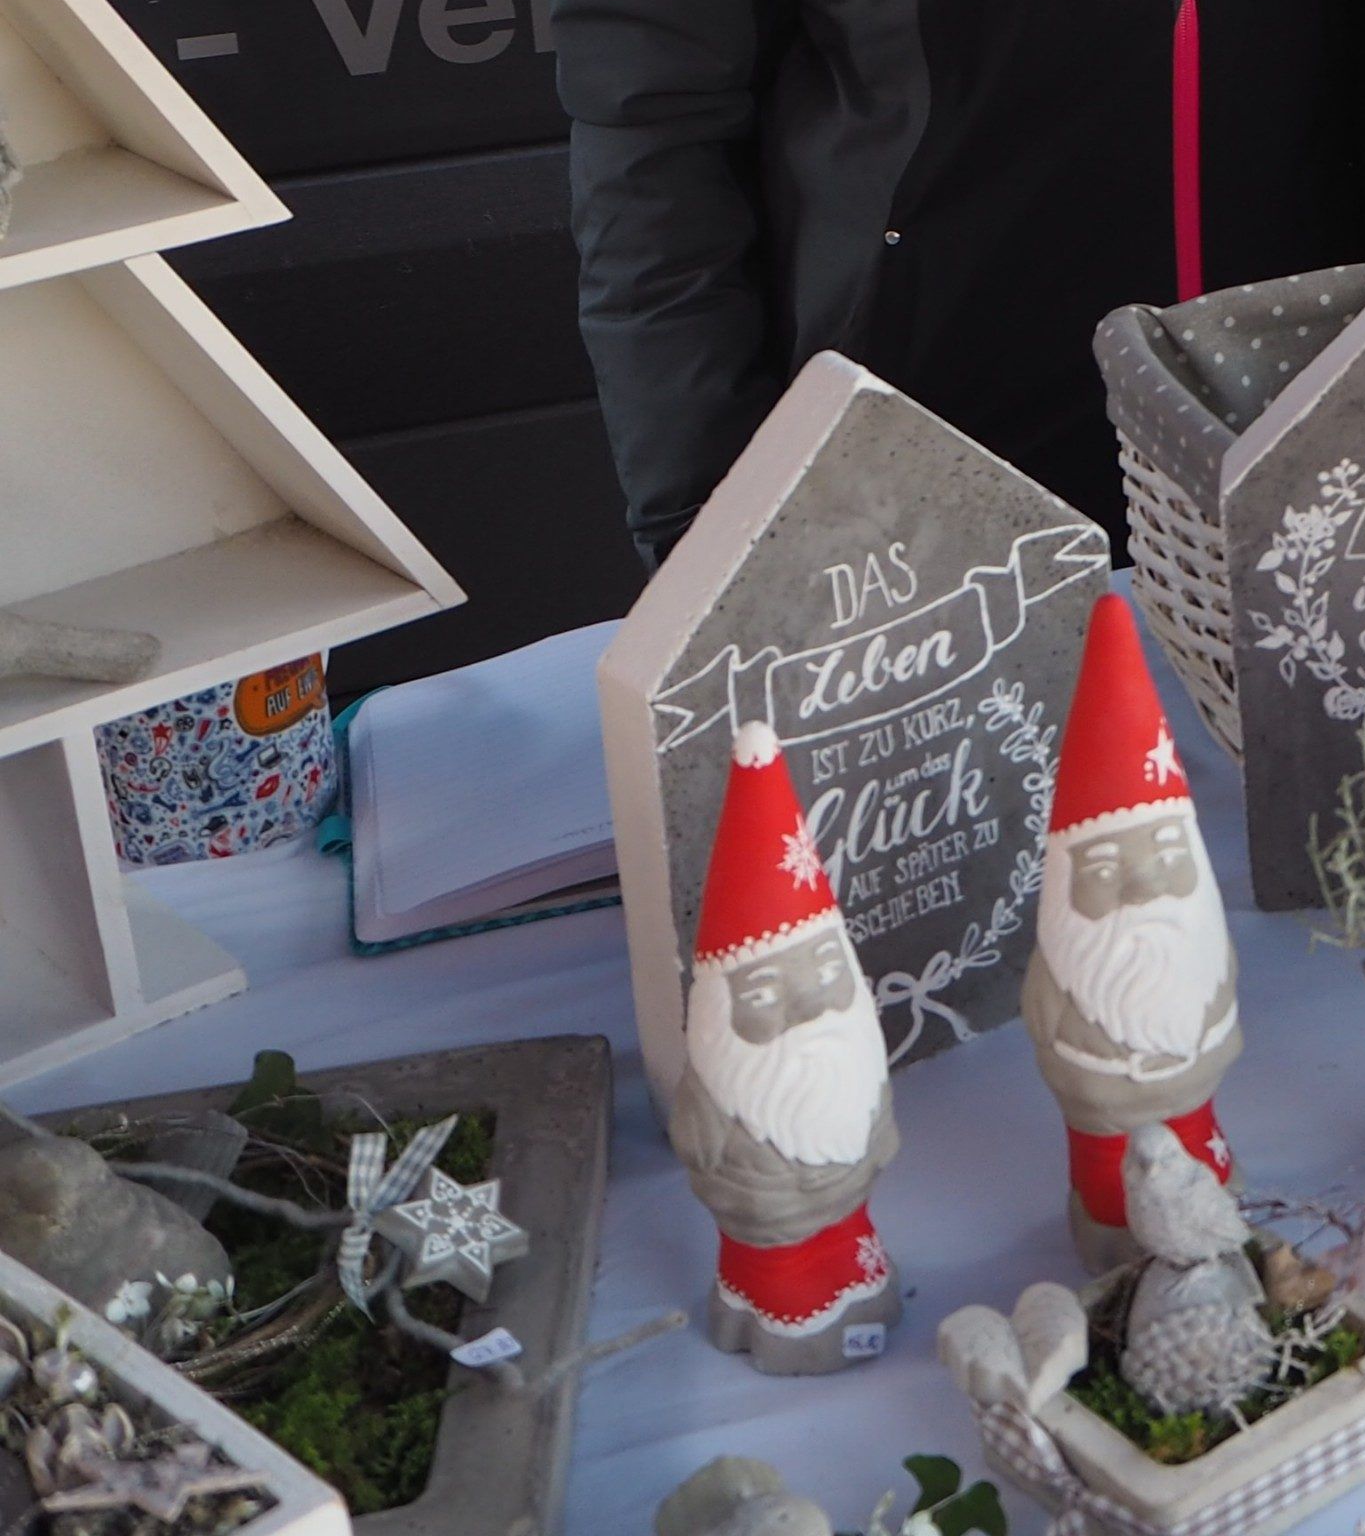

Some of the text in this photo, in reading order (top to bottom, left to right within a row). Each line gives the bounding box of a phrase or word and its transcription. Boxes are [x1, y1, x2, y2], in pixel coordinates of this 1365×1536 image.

[823, 541, 918, 630] DAS
[799, 629, 958, 720] Leben
[811, 697, 976, 786] IST ZU KURZ,
[846, 816, 1000, 908] AUF SPÄTER ZU
